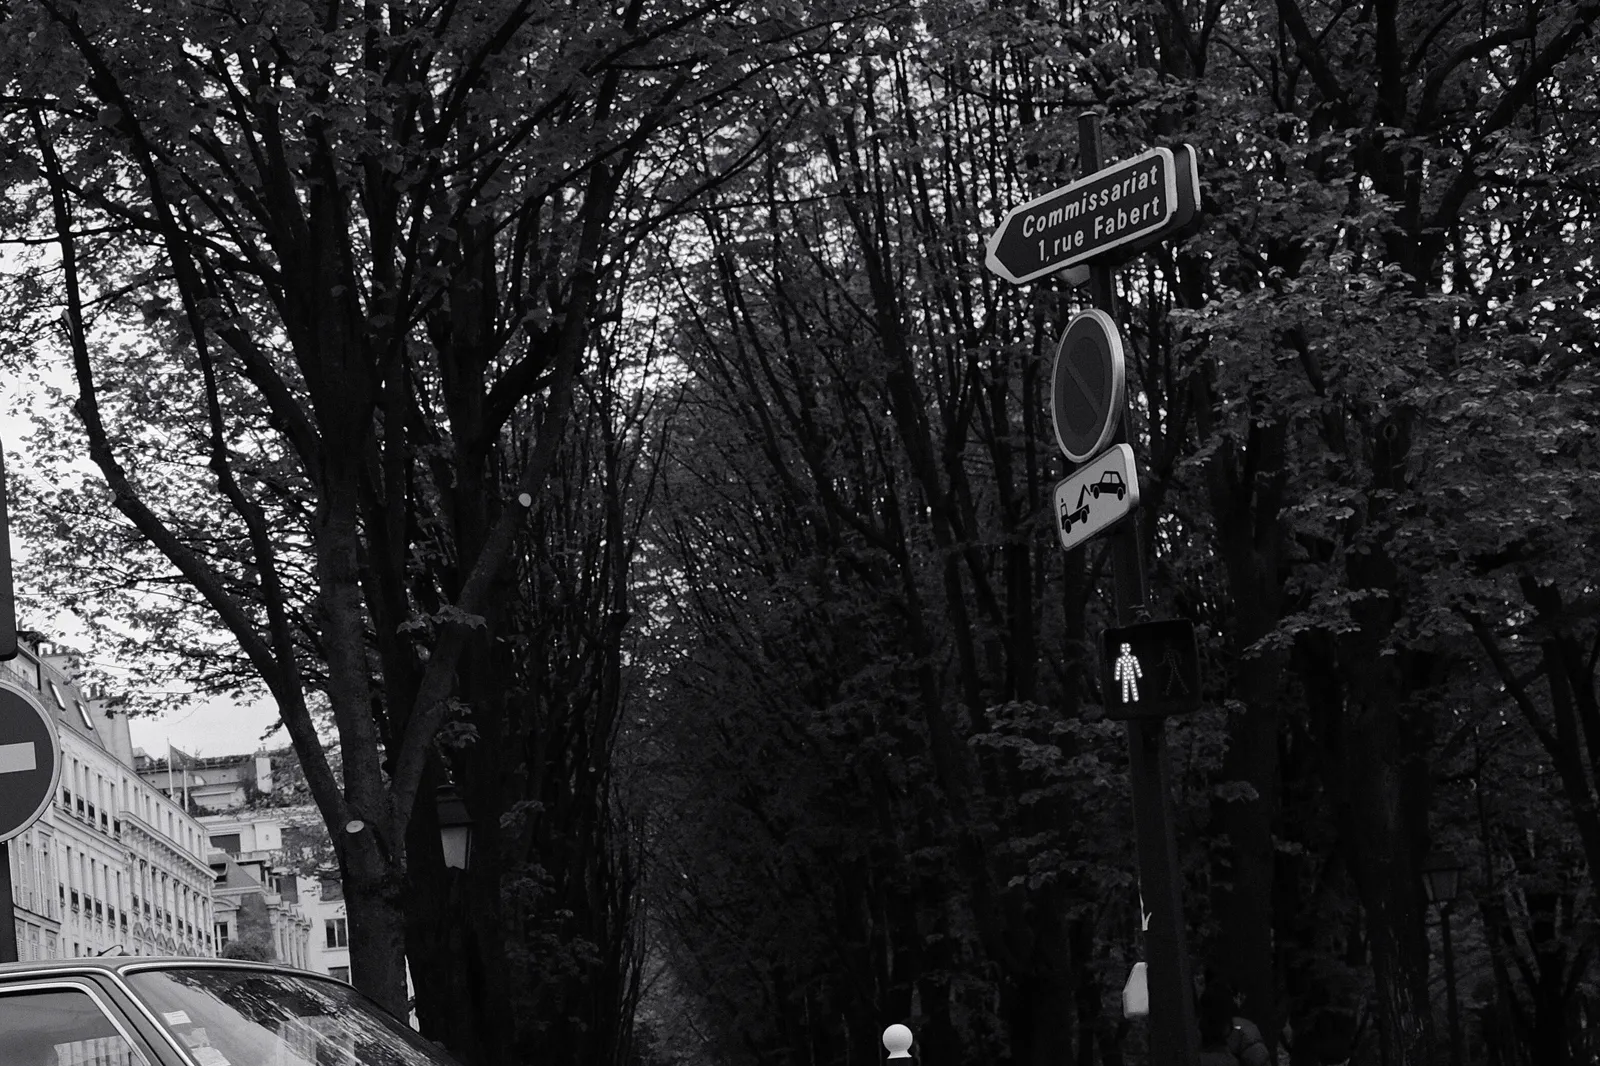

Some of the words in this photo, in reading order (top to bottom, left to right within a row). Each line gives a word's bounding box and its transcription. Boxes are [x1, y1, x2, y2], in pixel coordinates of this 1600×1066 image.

[1022, 165, 1158, 238] Commissariat
[1038, 239, 1050, 262] 1,
[1053, 229, 1084, 256] rue
[1094, 196, 1160, 240] Fabert
